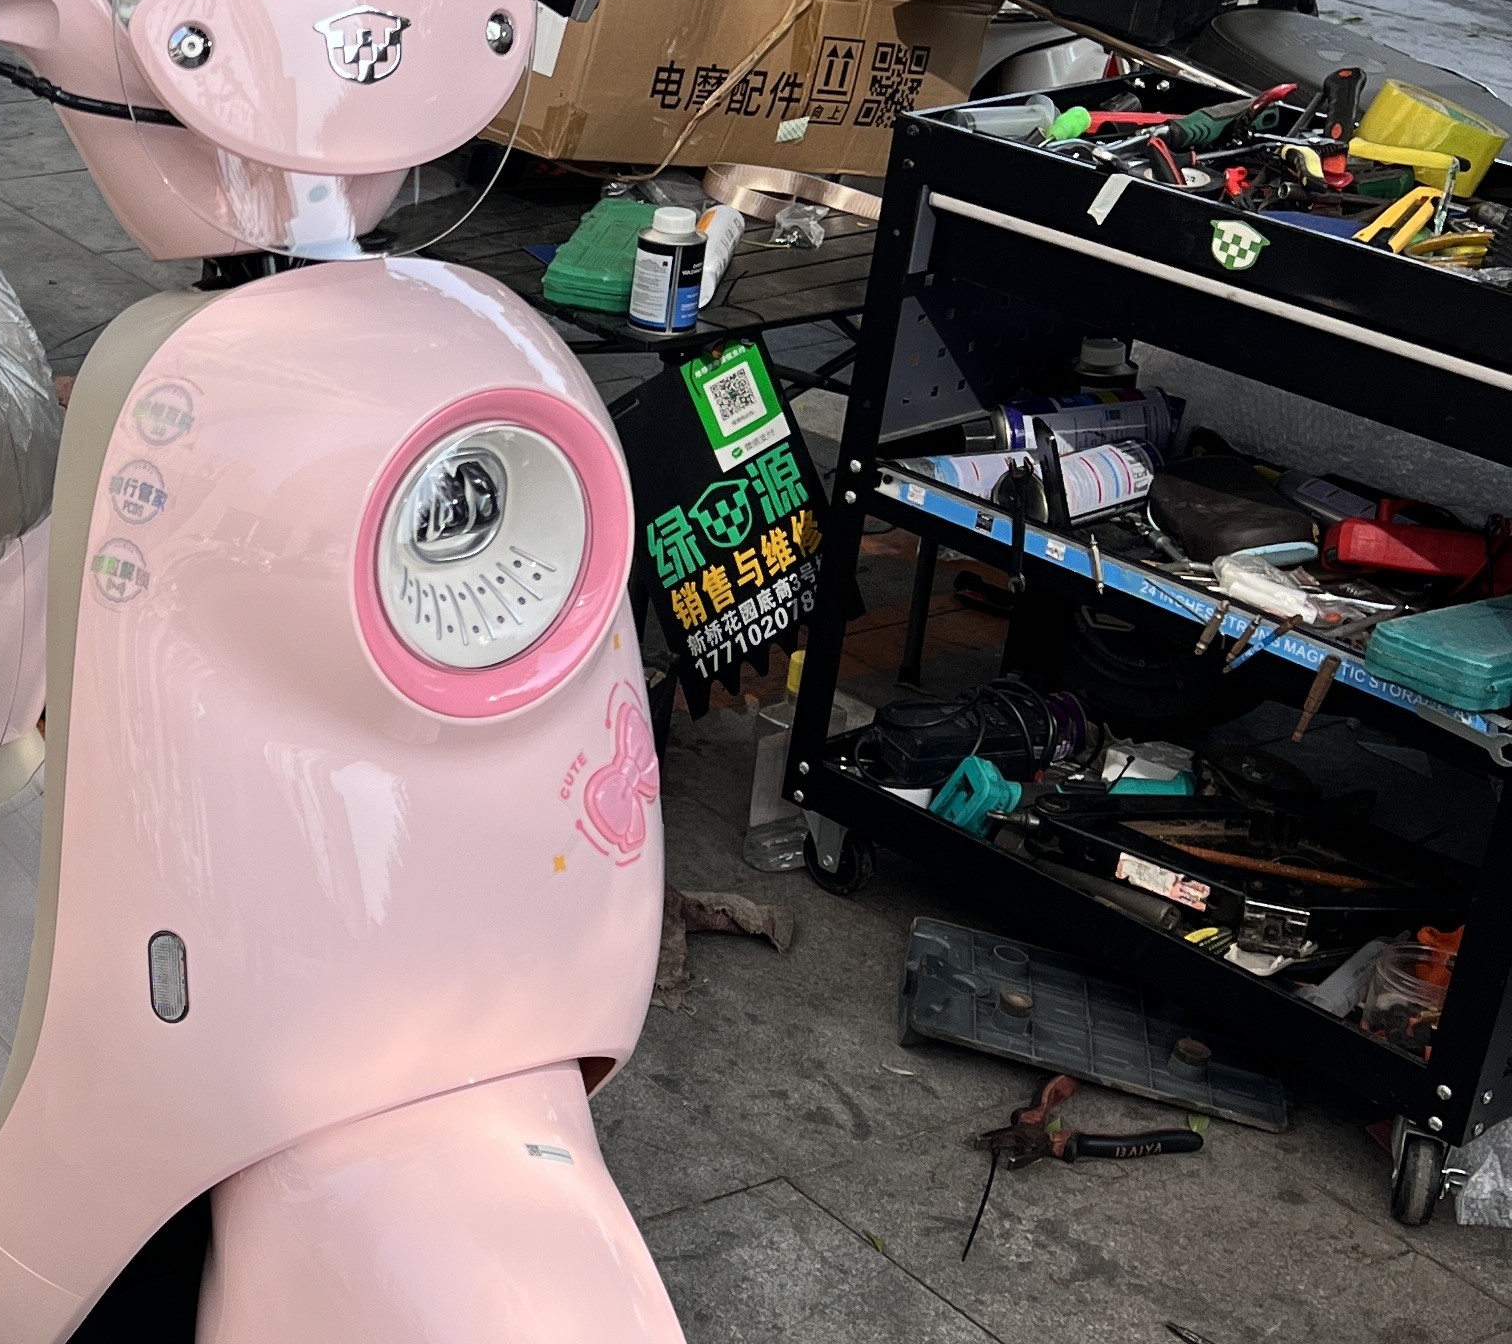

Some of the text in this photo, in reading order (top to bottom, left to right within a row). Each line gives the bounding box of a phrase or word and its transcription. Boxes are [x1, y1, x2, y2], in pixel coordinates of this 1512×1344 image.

[650, 60, 804, 120] 电摩配件
[810, 103, 841, 121] 向上
[670, 509, 823, 630] 销售与维修
[694, 584, 818, 679] 177102078
[1139, 580, 1158, 597] 24
[1221, 614, 1282, 649] TRNG
[1283, 638, 1367, 684] MAGTIC
[1368, 676, 1446, 712] STORA
[560, 752, 588, 800] CUTE
